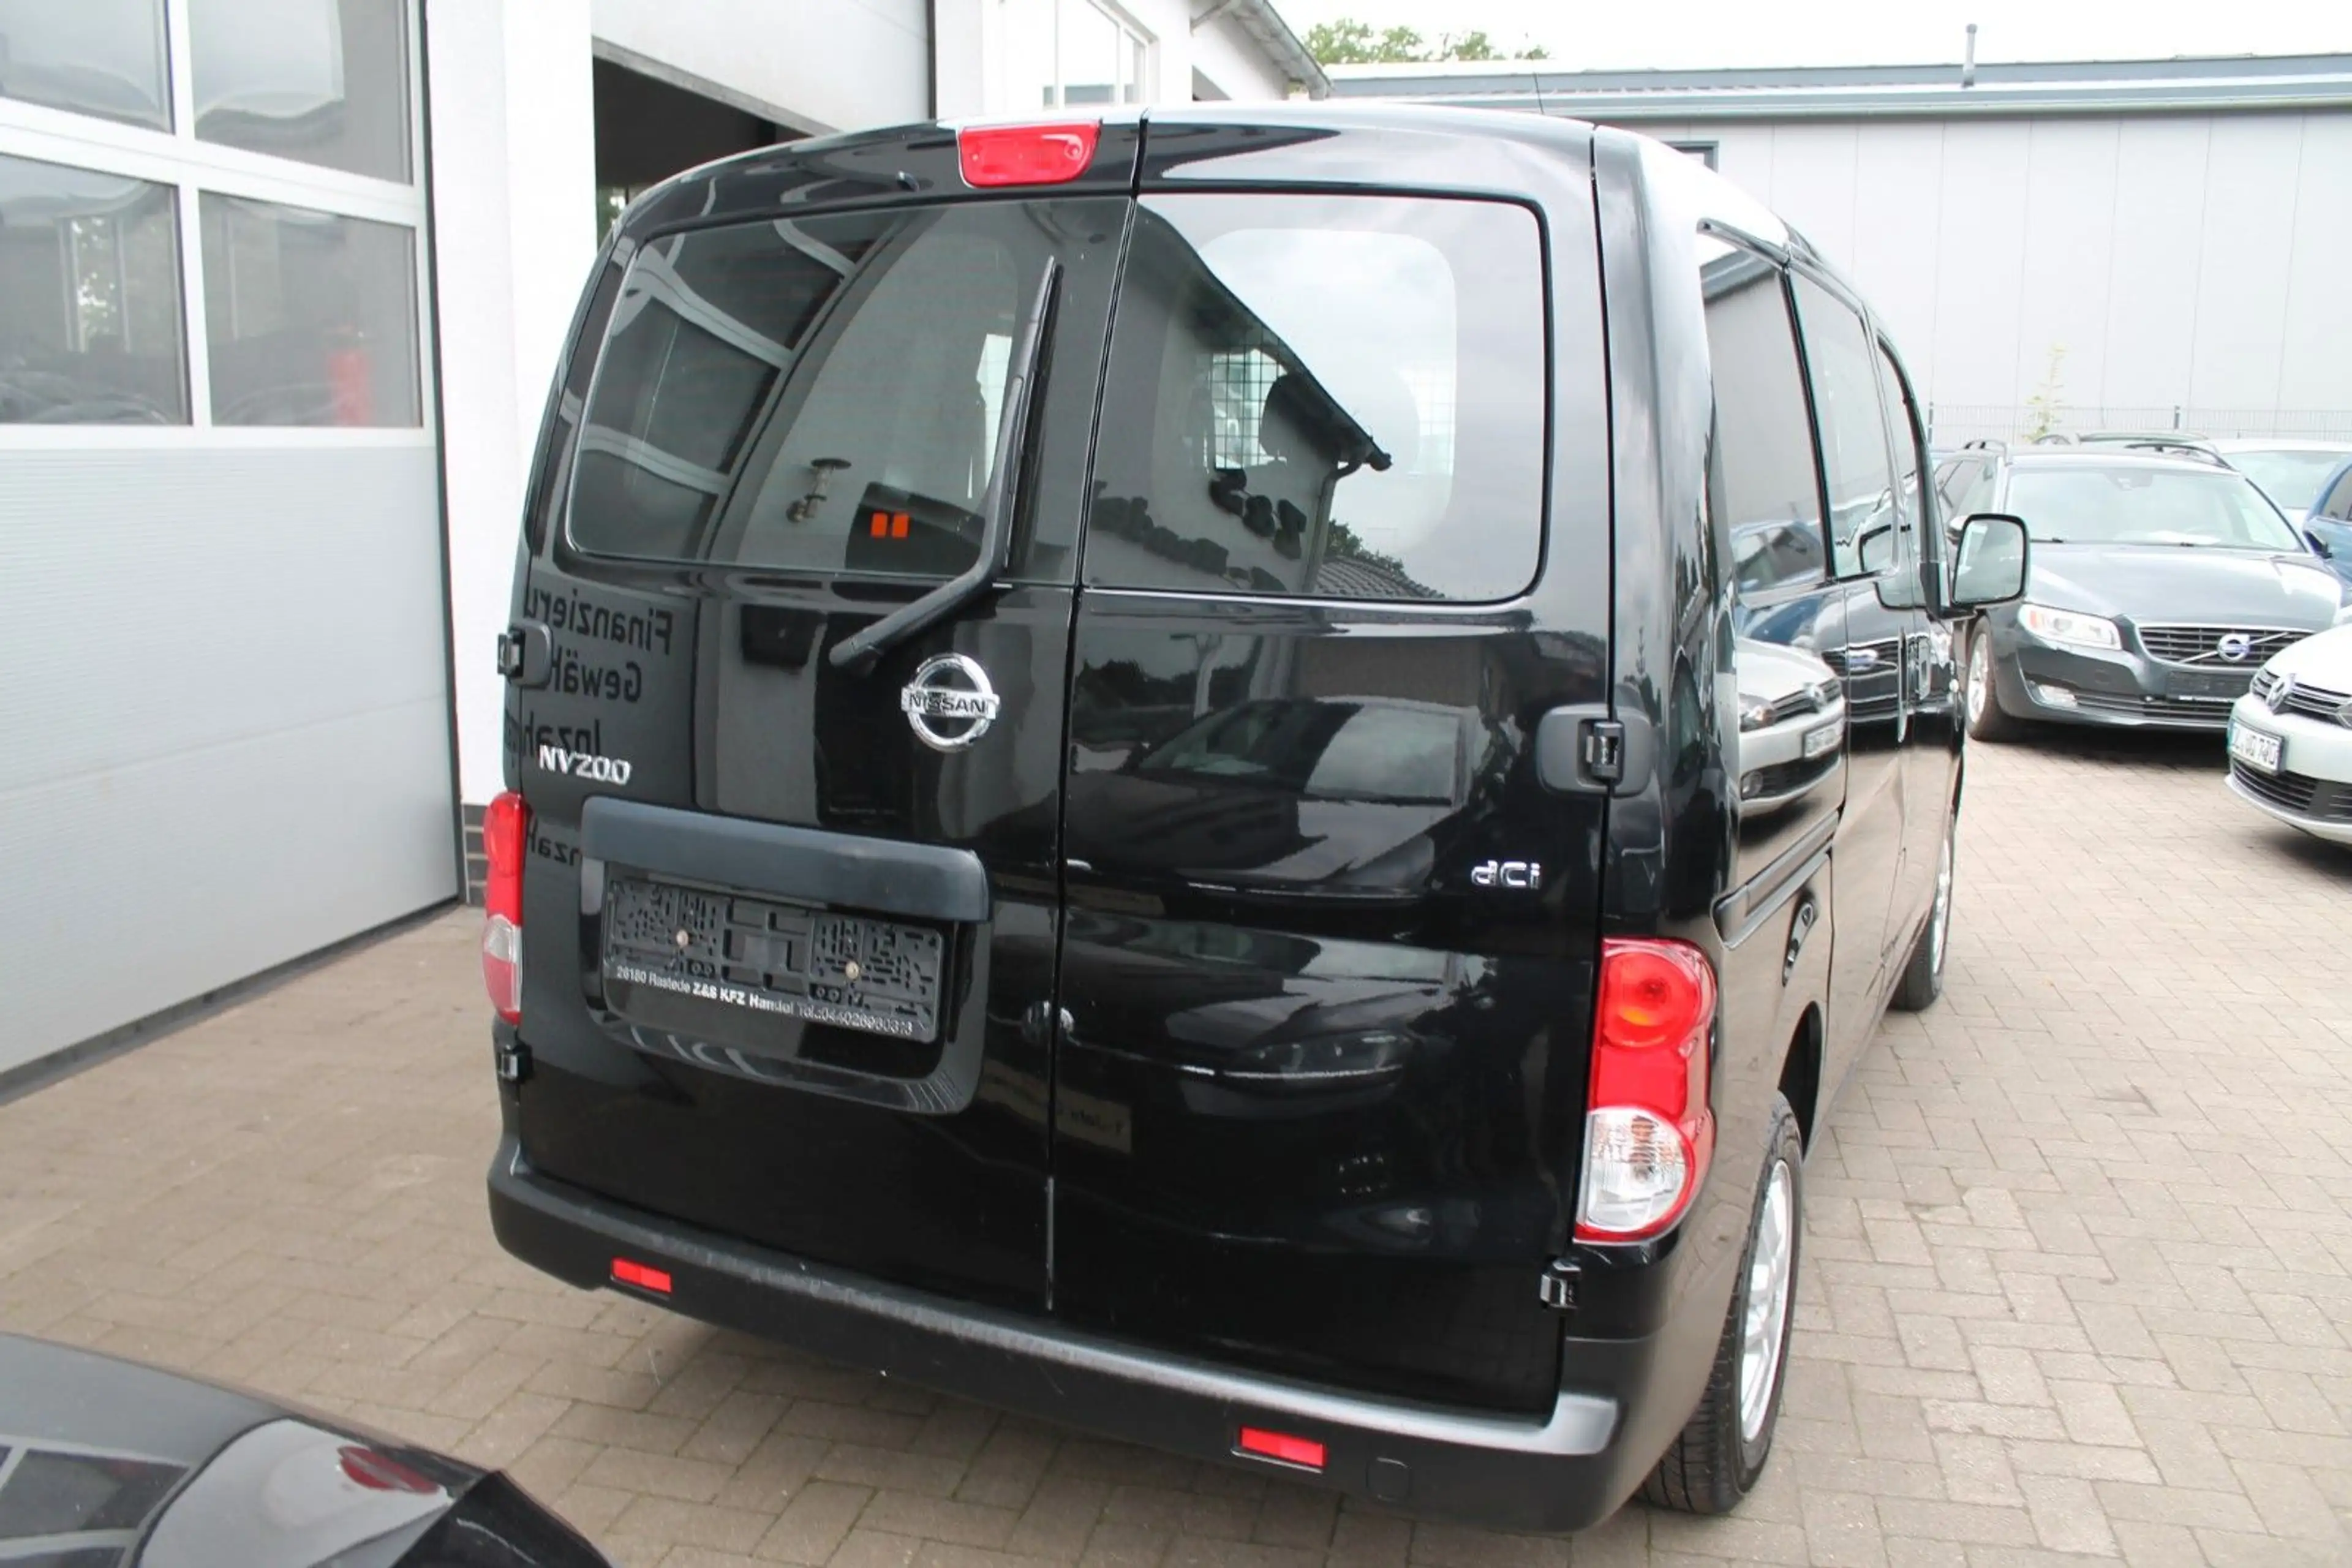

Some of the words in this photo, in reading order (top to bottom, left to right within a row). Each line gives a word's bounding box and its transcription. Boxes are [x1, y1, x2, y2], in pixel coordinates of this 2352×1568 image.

[908, 692, 986, 714] NISSAN
[538, 744, 631, 786] NV200
[1471, 859, 1541, 889] dCi
[692, 982, 717, 1000] Z&S
[720, 987, 745, 1006] KFZ
